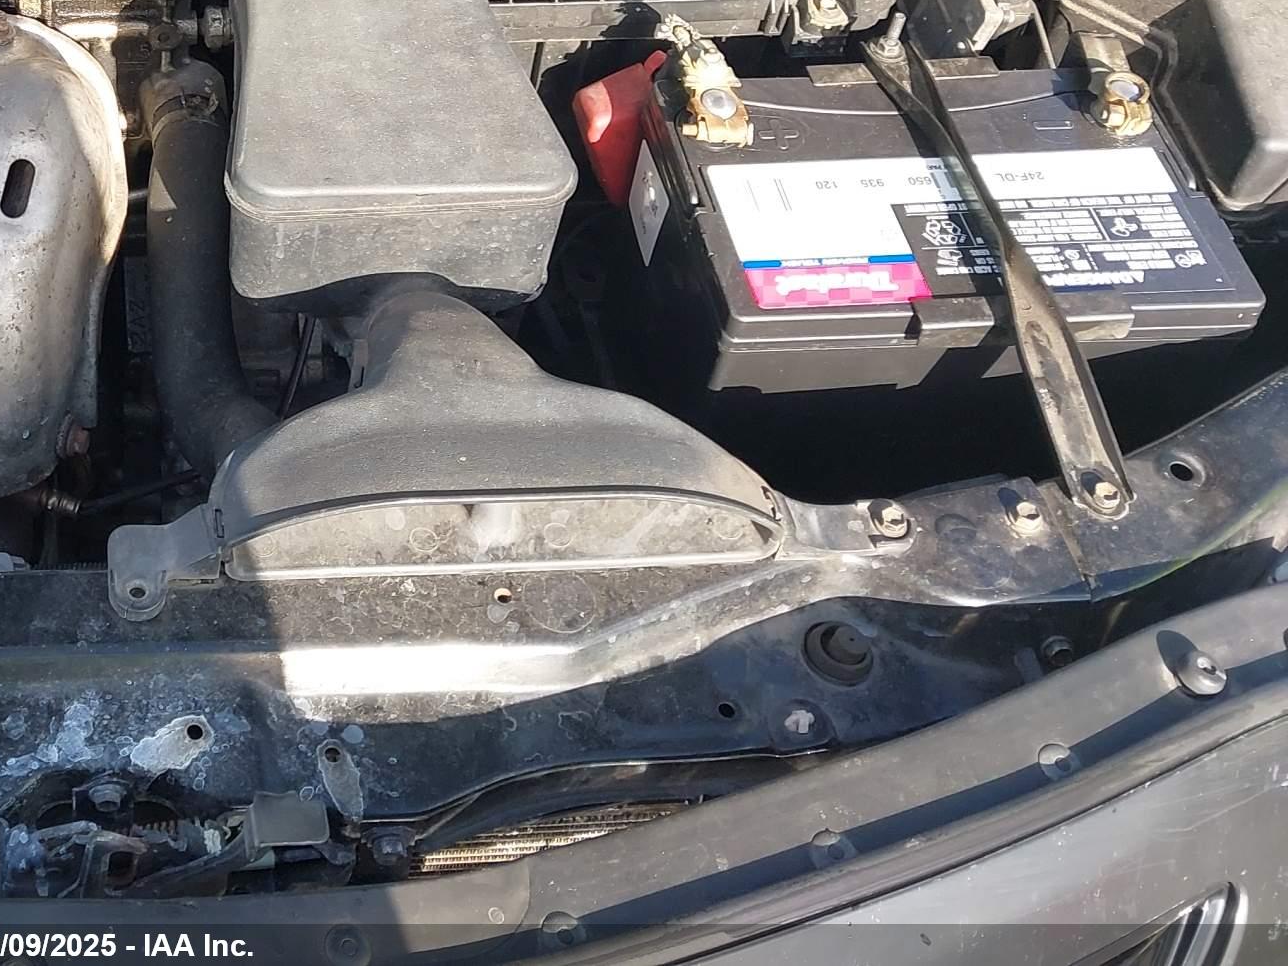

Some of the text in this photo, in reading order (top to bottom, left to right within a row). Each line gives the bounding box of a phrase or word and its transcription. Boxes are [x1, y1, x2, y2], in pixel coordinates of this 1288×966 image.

[815, 176, 932, 189] 650 935 120
[994, 171, 1045, 182] 24F-DL
